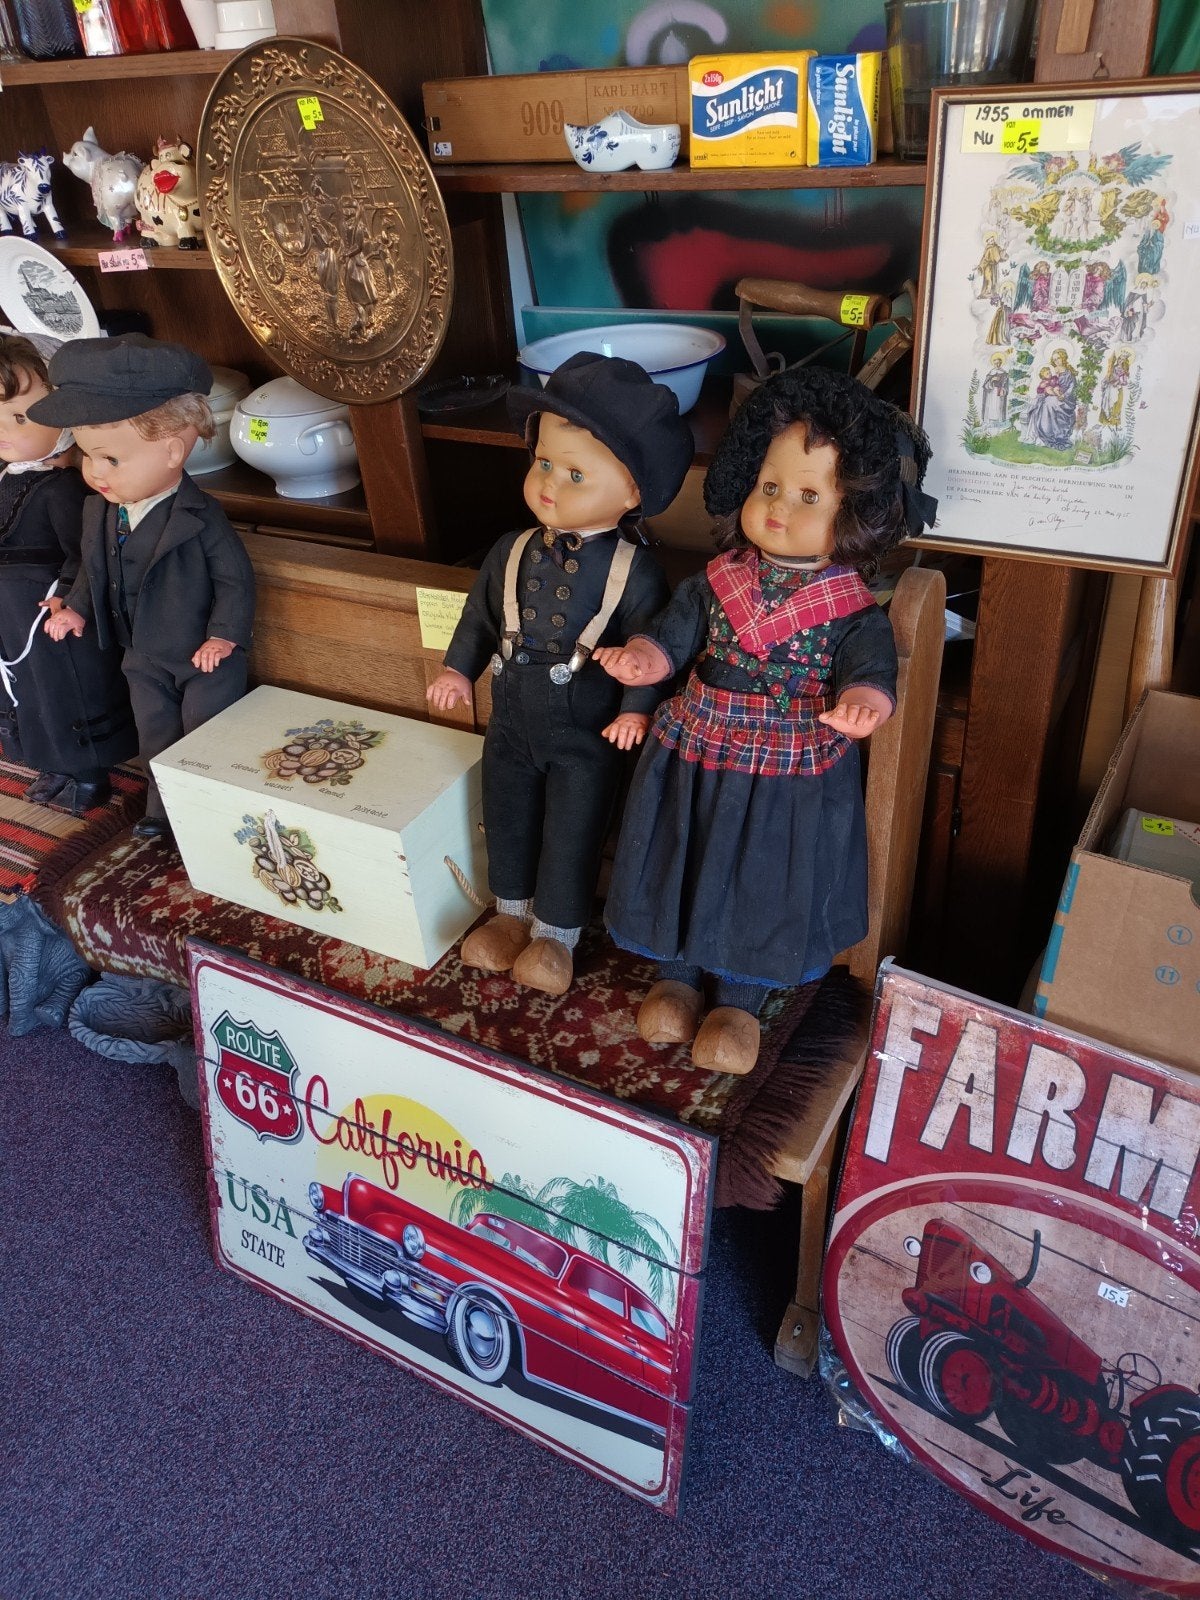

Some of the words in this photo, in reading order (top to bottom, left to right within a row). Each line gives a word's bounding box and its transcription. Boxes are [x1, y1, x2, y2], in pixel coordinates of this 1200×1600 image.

[593, 84, 627, 98] KARL
[631, 82, 669, 97] HART
[704, 73, 722, 84] 2x150g
[521, 100, 565, 136] 909
[705, 77, 784, 128] Sunlight
[738, 111, 755, 123] SAVON
[763, 100, 781, 112] SAPONE
[828, 62, 855, 155] Sunlight
[975, 106, 1010, 122] 1955
[225, 1025, 281, 1068] ROUTE
[234, 1071, 280, 1121] 66
[864, 993, 1200, 1220] FARM
[305, 1074, 495, 1192] California
[224, 1167, 299, 1240] USA
[241, 1229, 285, 1268] STATE
[981, 1461, 1069, 1525] Life
